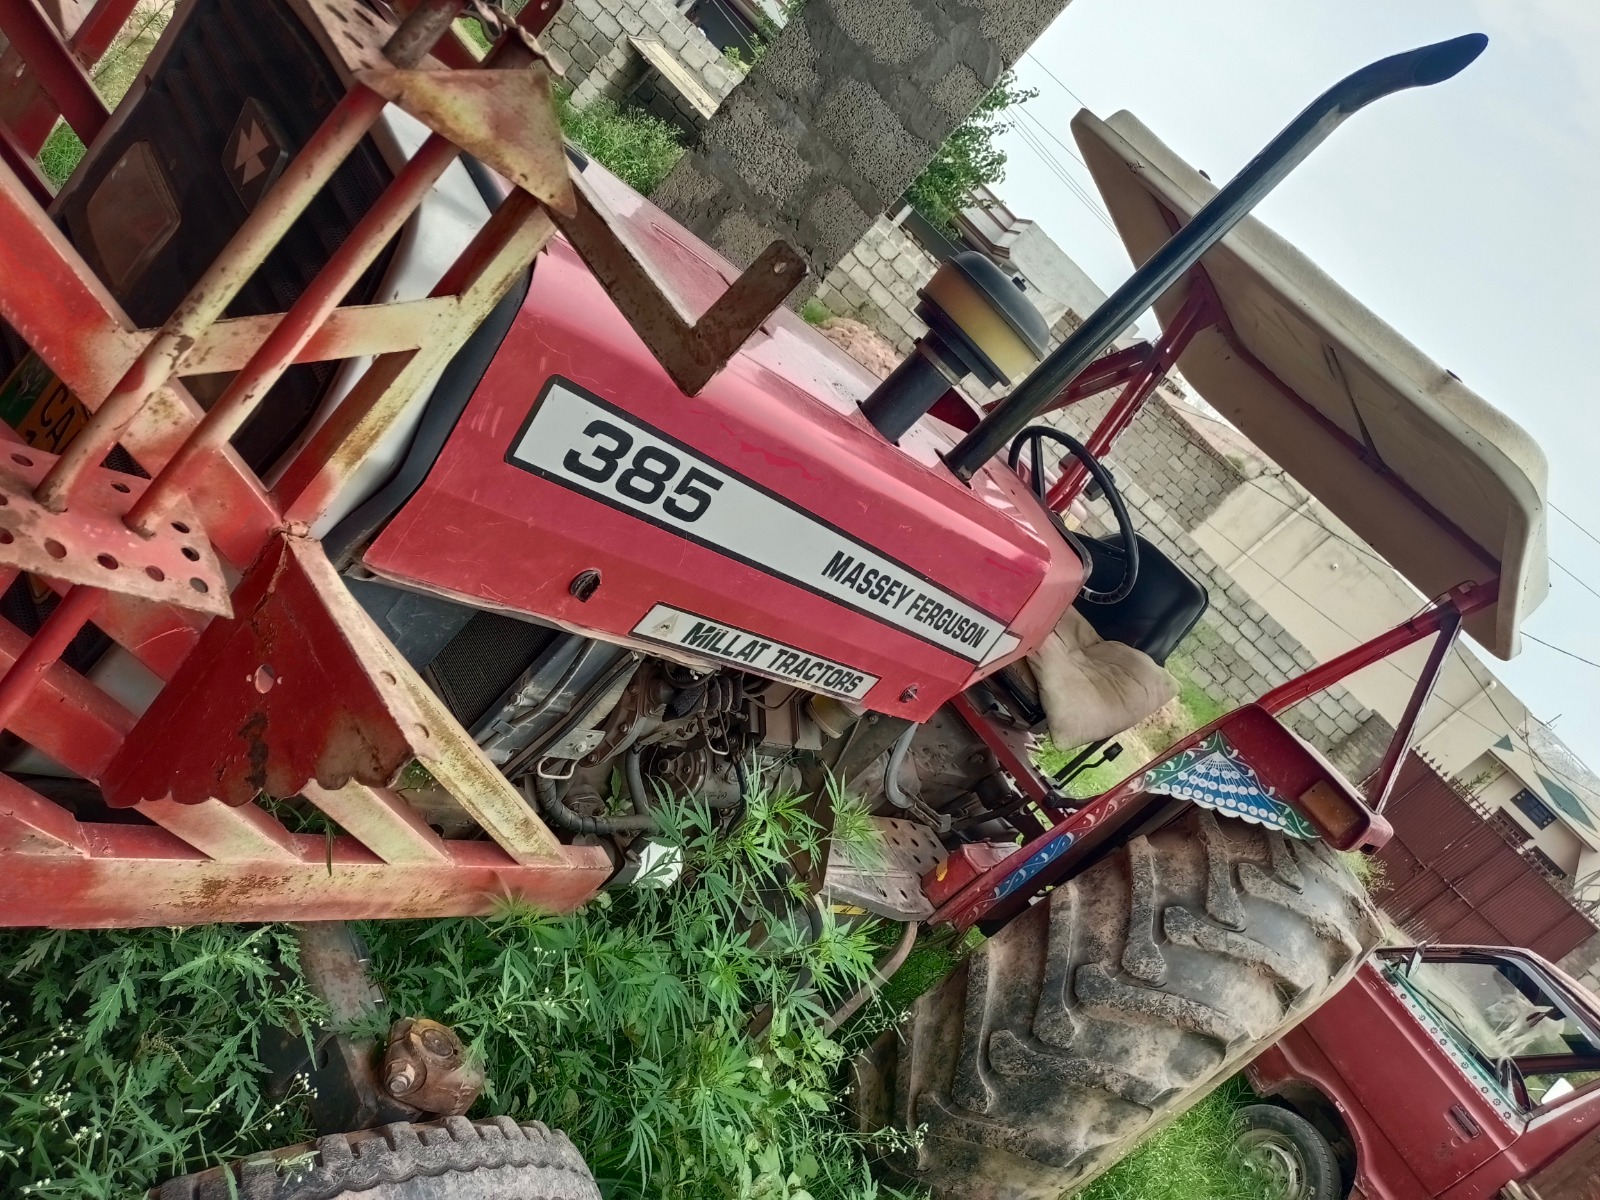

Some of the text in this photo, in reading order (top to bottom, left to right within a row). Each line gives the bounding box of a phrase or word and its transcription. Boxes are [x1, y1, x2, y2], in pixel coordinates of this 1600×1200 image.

[563, 419, 724, 523] 385
[821, 550, 989, 648] MASSEY FERGUSON
[680, 622, 864, 693] MILLAT TRACTORS
